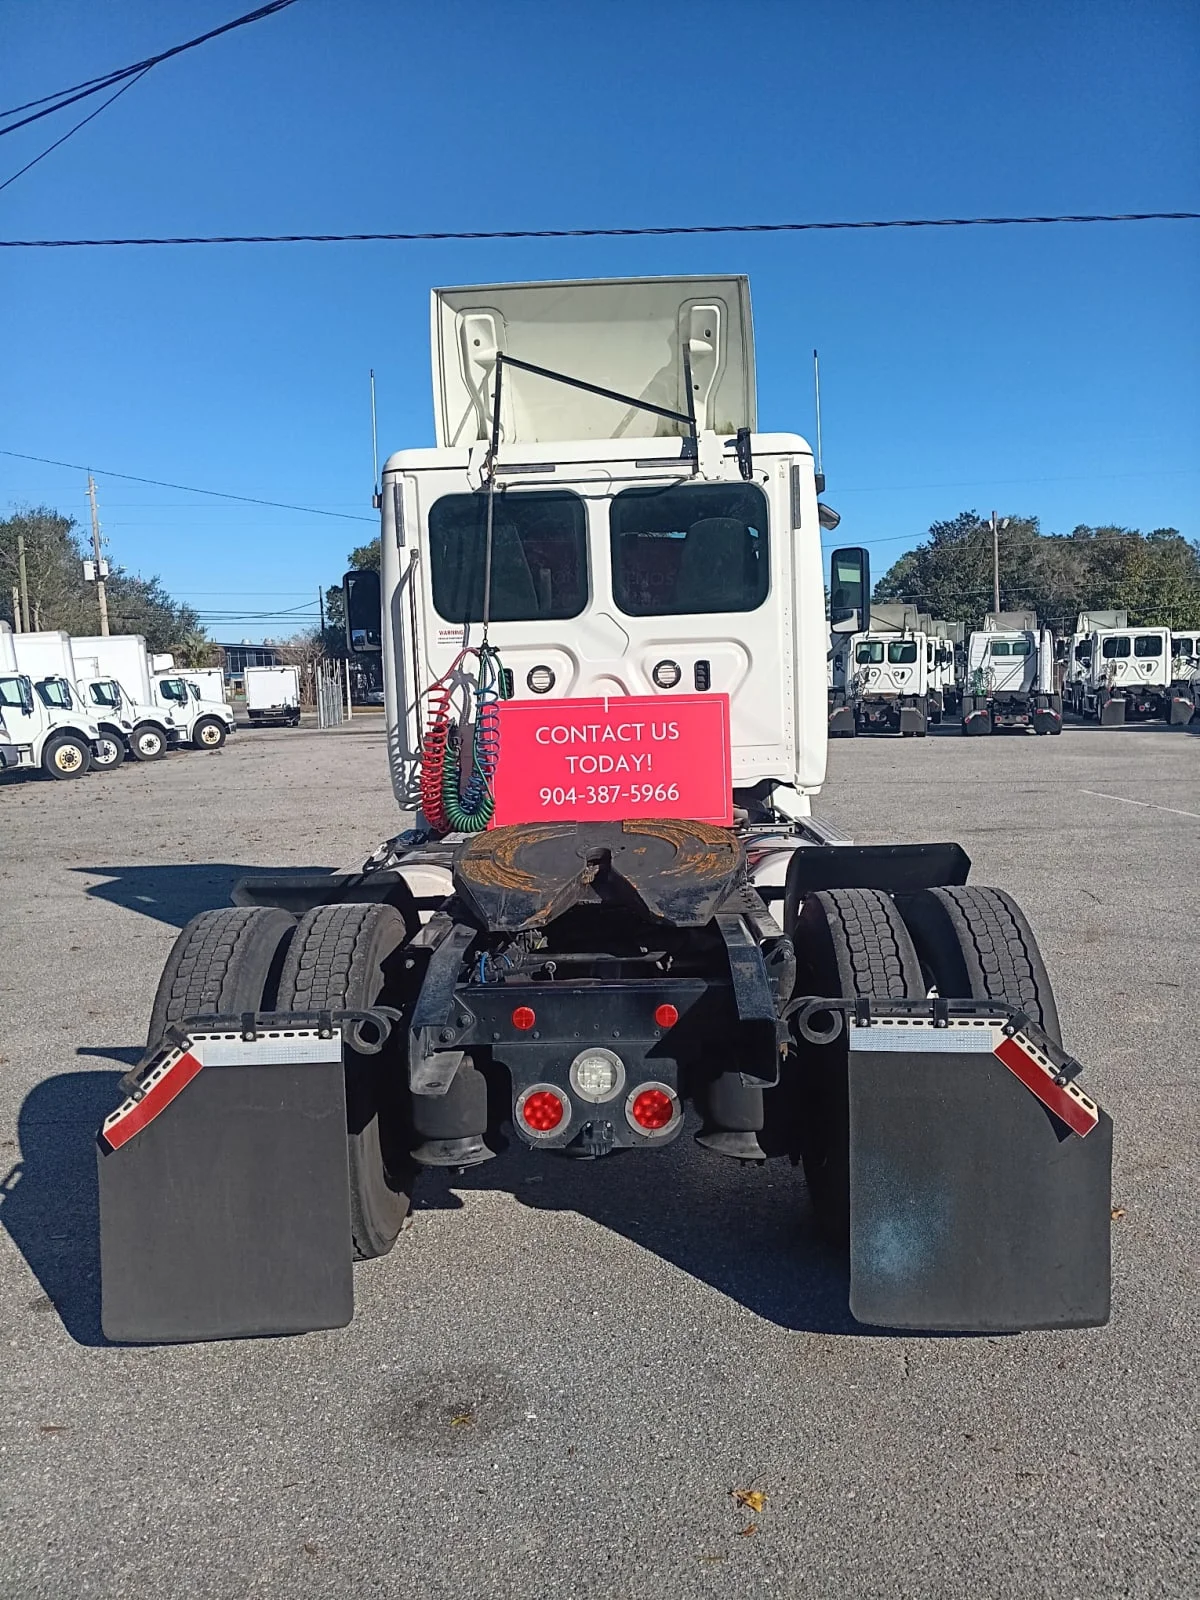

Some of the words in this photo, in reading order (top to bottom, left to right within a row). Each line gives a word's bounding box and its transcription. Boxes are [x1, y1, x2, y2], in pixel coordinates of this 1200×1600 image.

[535, 722, 645, 745] CONTACT
[651, 721, 680, 741] US
[565, 753, 653, 774] TODAY!
[539, 782, 680, 806] 904-387-5966
